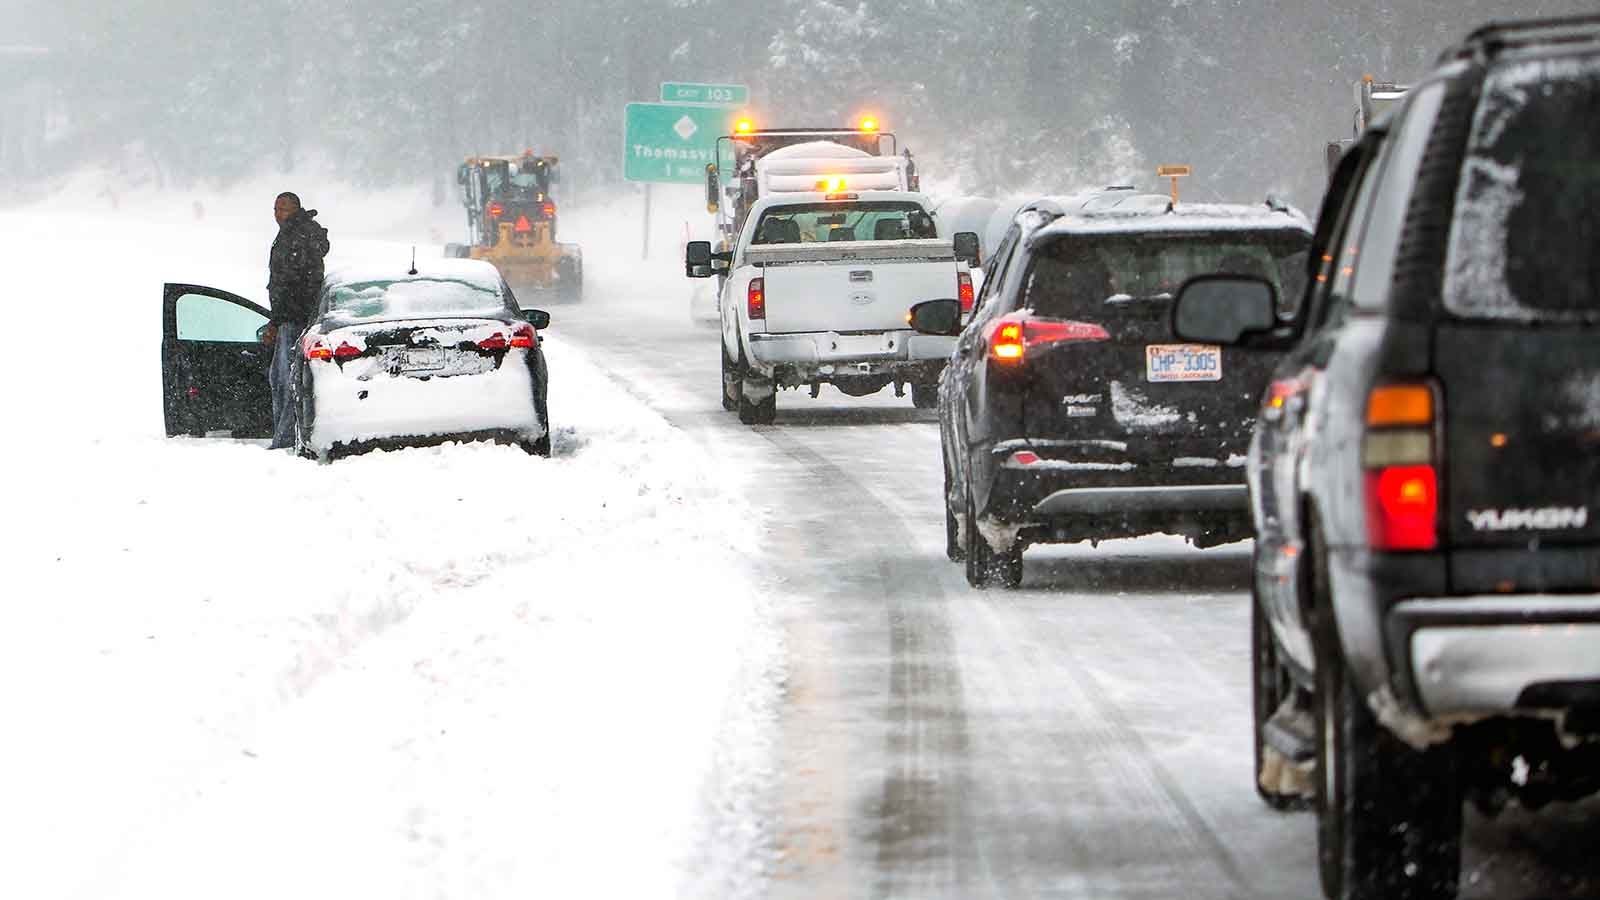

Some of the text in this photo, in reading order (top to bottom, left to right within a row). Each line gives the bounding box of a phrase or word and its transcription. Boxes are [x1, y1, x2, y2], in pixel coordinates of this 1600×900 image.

[708, 88, 733, 101] 103
[633, 144, 736, 160] Thomasvile
[1152, 353, 1217, 371] CHP-3305
[1466, 505, 1588, 531] YUKON
